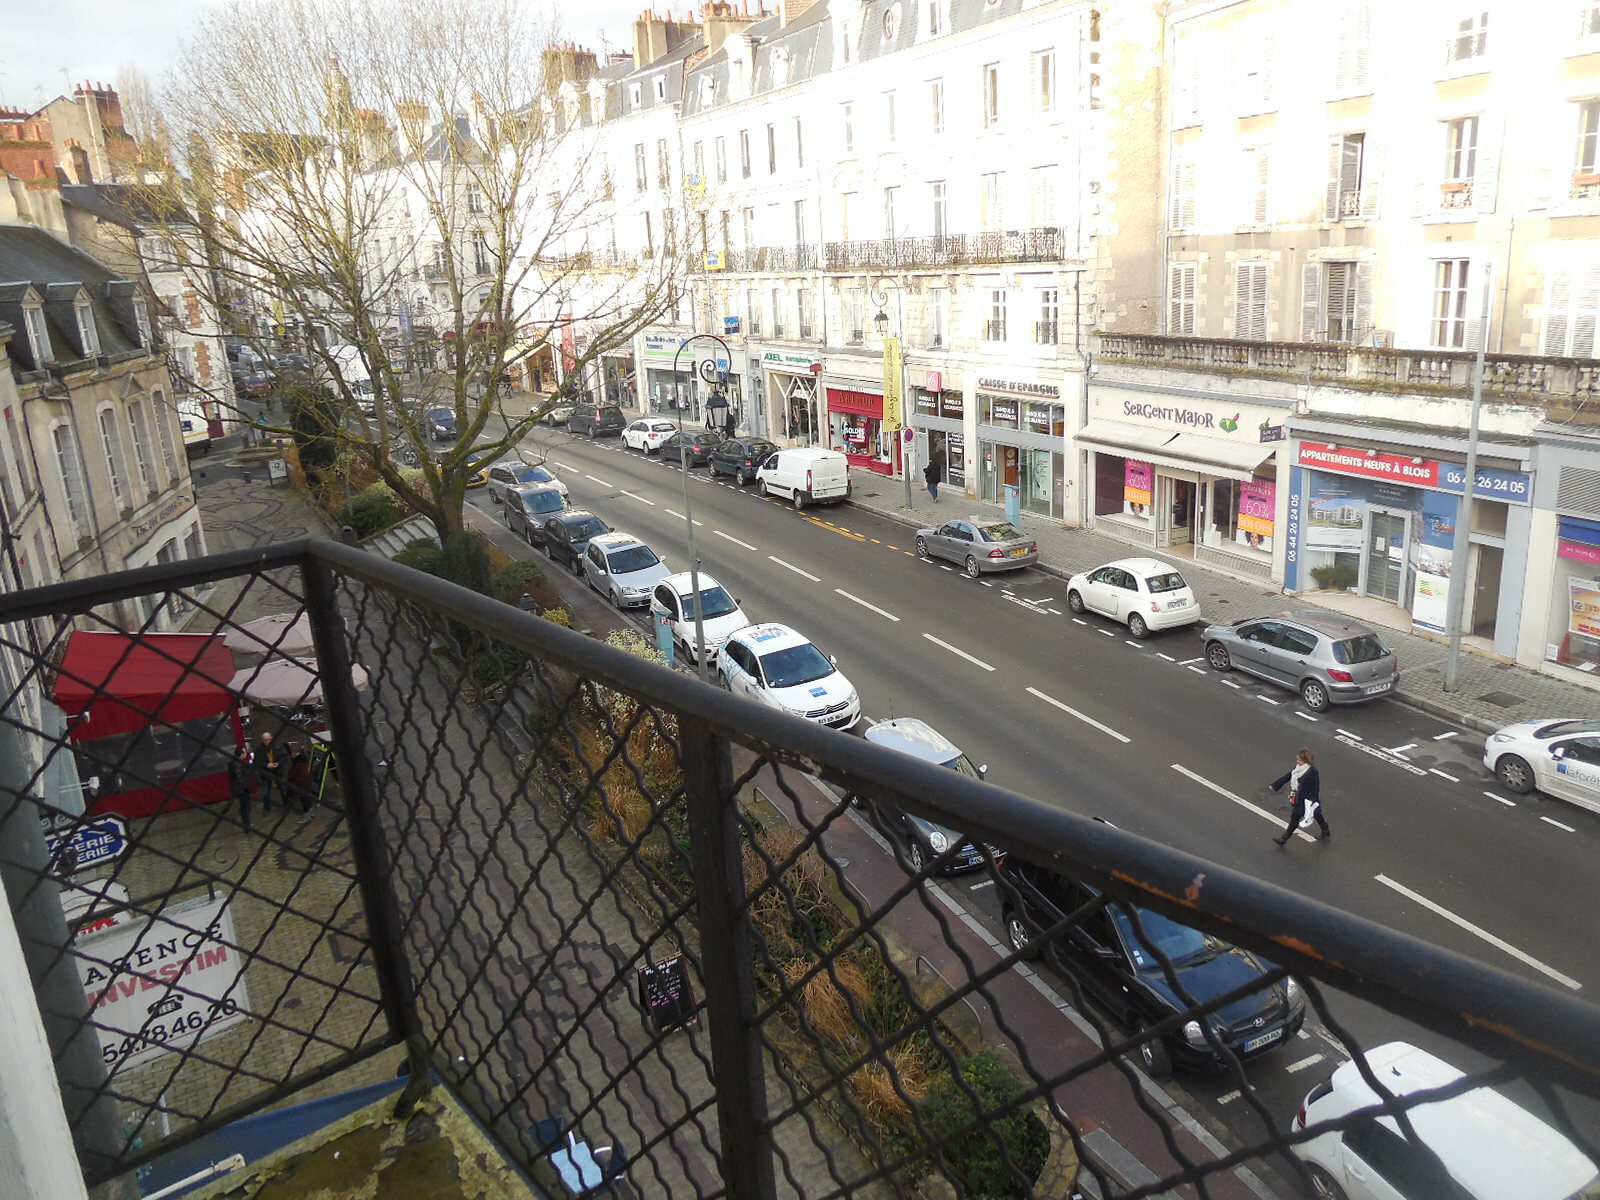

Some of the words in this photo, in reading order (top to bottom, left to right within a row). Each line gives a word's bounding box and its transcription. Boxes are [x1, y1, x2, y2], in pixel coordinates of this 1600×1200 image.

[978, 378, 1007, 389] CAISSE
[839, 391, 874, 407] ARTHUR
[1300, 449, 1362, 467] APPARTEMENTS
[1364, 459, 1391, 472] NEUFS
[1403, 466, 1431, 479] BLOIS
[1447, 472, 1460, 483] 06
[1478, 476, 1492, 488] 26
[1493, 479, 1507, 491] 24
[1510, 481, 1525, 494] 05
[1291, 494, 1299, 507] 05
[1291, 508, 1298, 521] 24
[1290, 522, 1297, 535] 26
[1289, 536, 1297, 549] 44
[1288, 550, 1296, 562] 06
[84, 923, 223, 987] AGENCE
[86, 945, 228, 1009] INVESTIM
